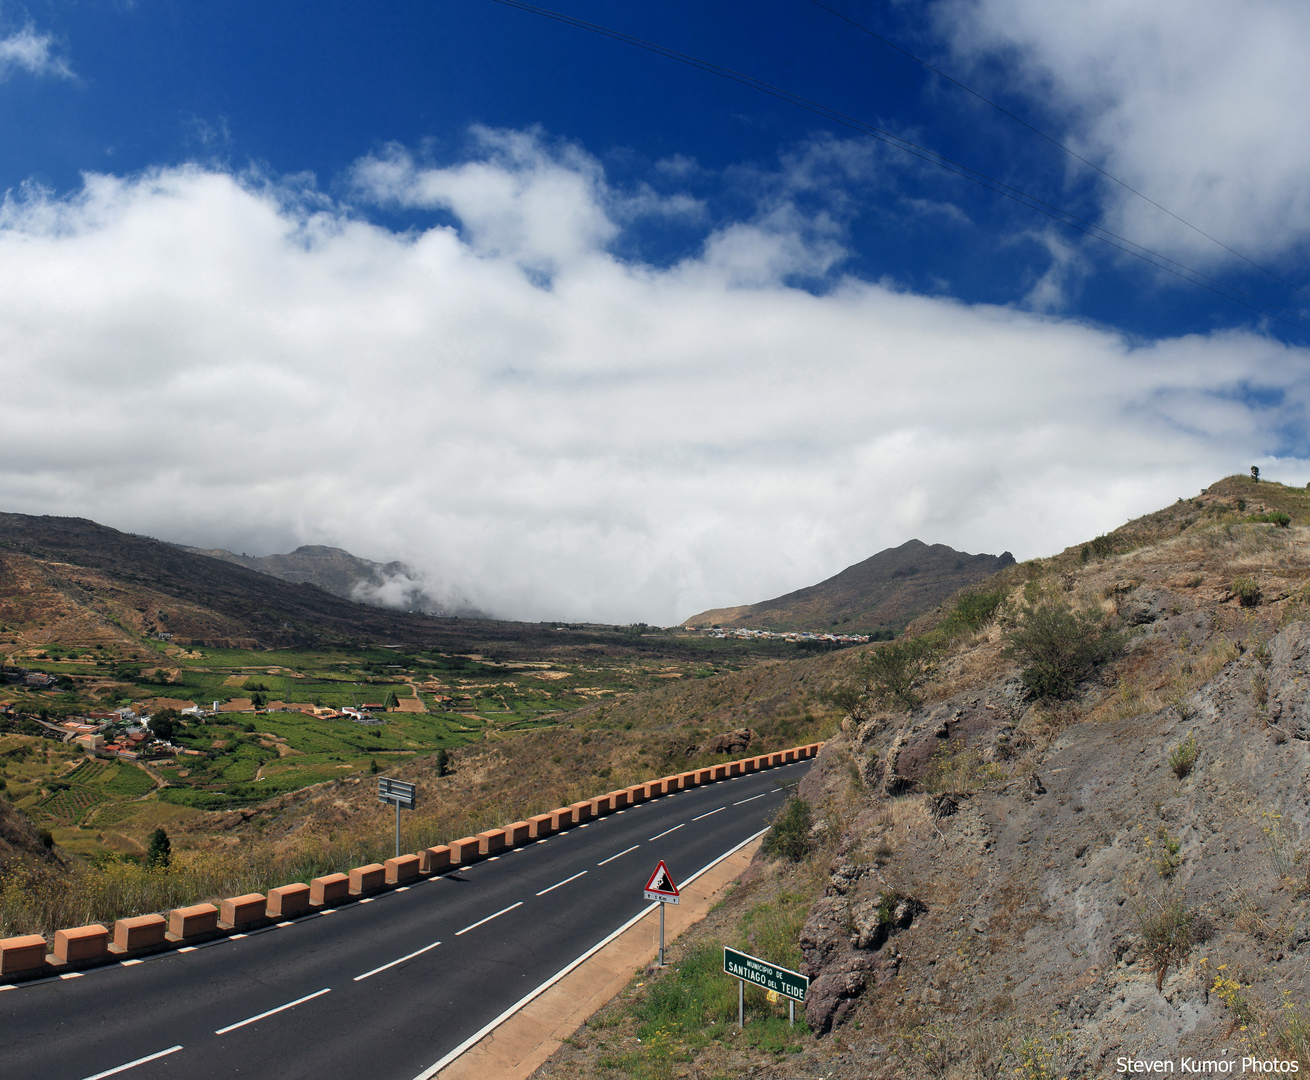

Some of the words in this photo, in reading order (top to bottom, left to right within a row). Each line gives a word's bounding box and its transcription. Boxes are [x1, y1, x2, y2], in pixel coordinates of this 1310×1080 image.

[728, 961, 766, 984] SANTIAGO
[767, 979, 778, 990] DEL
[781, 981, 804, 999] TEIDE
[746, 960, 773, 976] MUNICIPIO
[775, 971, 783, 980] DE
